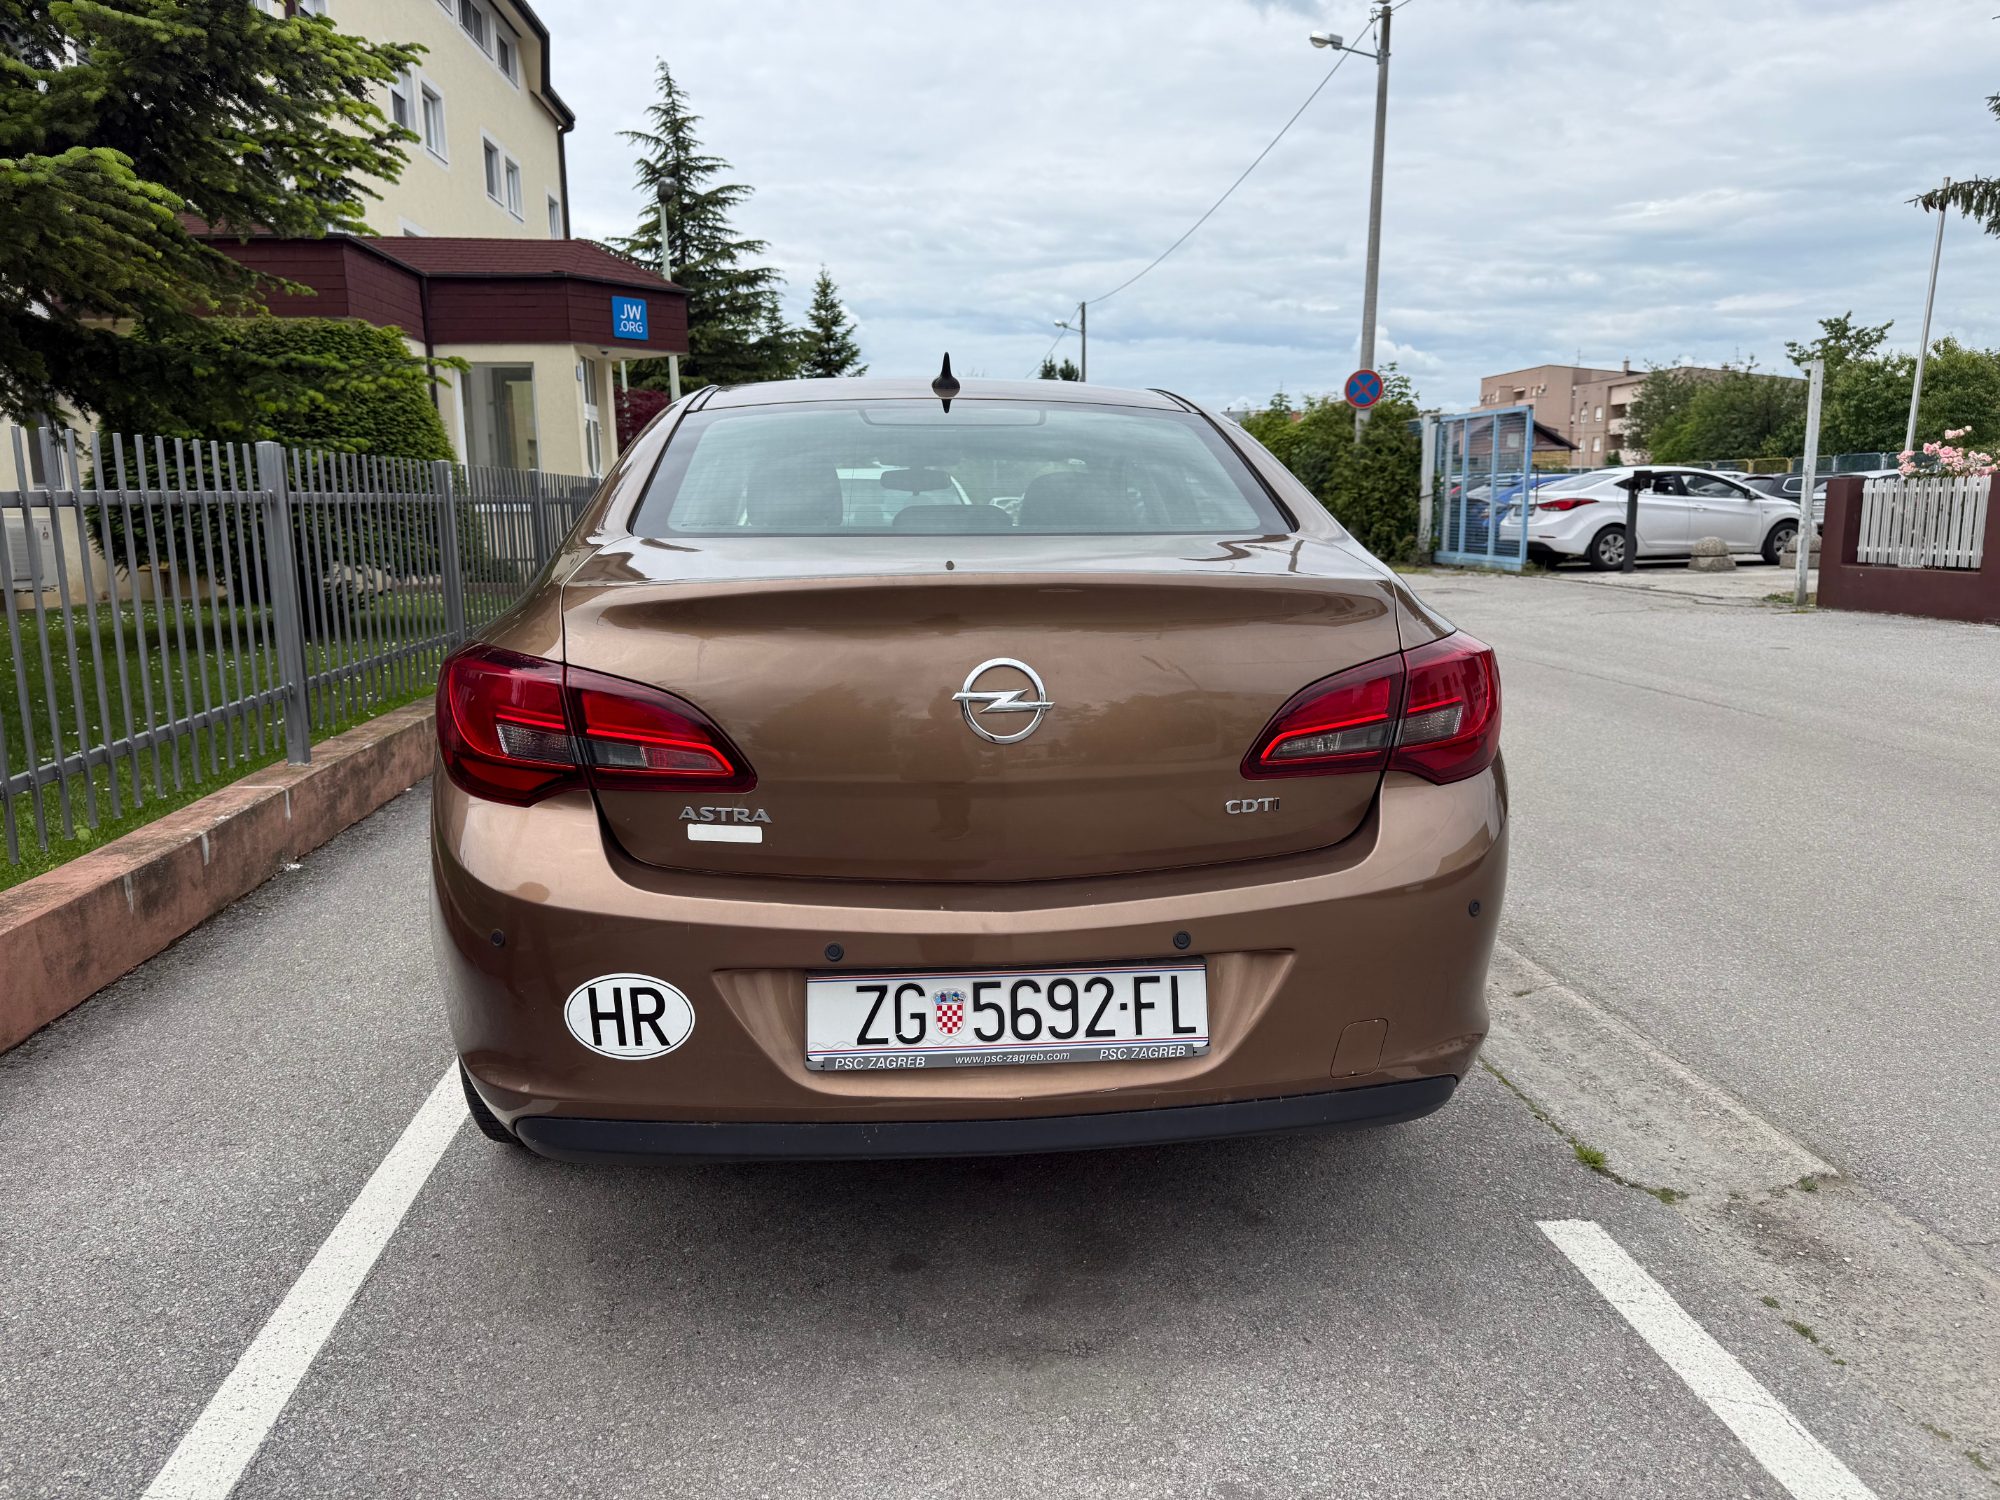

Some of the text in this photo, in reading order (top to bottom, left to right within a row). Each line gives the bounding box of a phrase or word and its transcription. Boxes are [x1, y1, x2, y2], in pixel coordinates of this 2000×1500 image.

[620, 304, 642, 320] JW
[619, 320, 643, 333] .ORG
[678, 805, 773, 823] ASTRA
[587, 986, 671, 1047] HR
[856, 983, 927, 1046] ZG
[954, 1051, 1070, 1065] www.psc-zagreb.com
[1099, 1045, 1186, 1060] PSC ZAGREB
[835, 1056, 926, 1070] PSC ZAGREB
